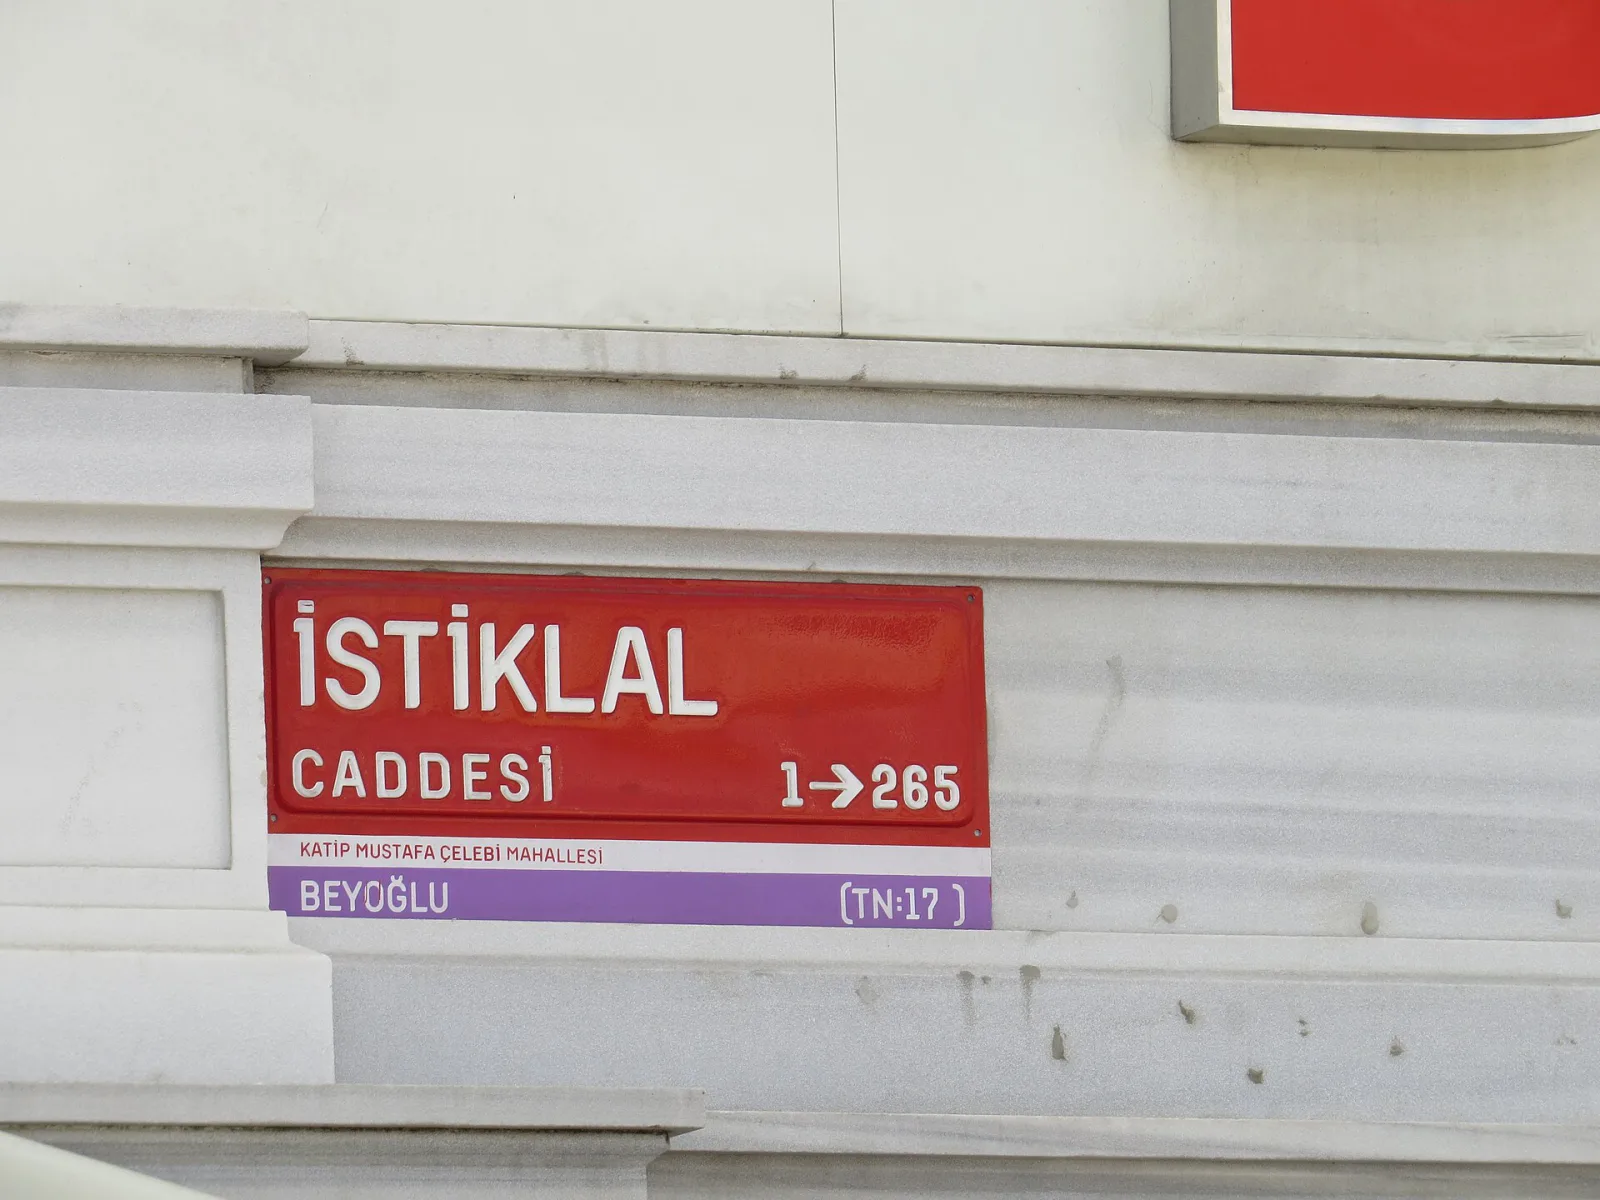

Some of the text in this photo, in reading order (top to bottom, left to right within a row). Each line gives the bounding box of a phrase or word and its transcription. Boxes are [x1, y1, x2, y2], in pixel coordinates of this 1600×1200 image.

[293, 600, 719, 716] İSTİKLAL
[292, 746, 553, 802] CADDESİ
[780, 761, 961, 811] 1 265
[300, 840, 603, 865] KATİP MUSTAFA ÇELEBİ MAHALLESİ
[300, 875, 449, 914] BEYOĞLU
